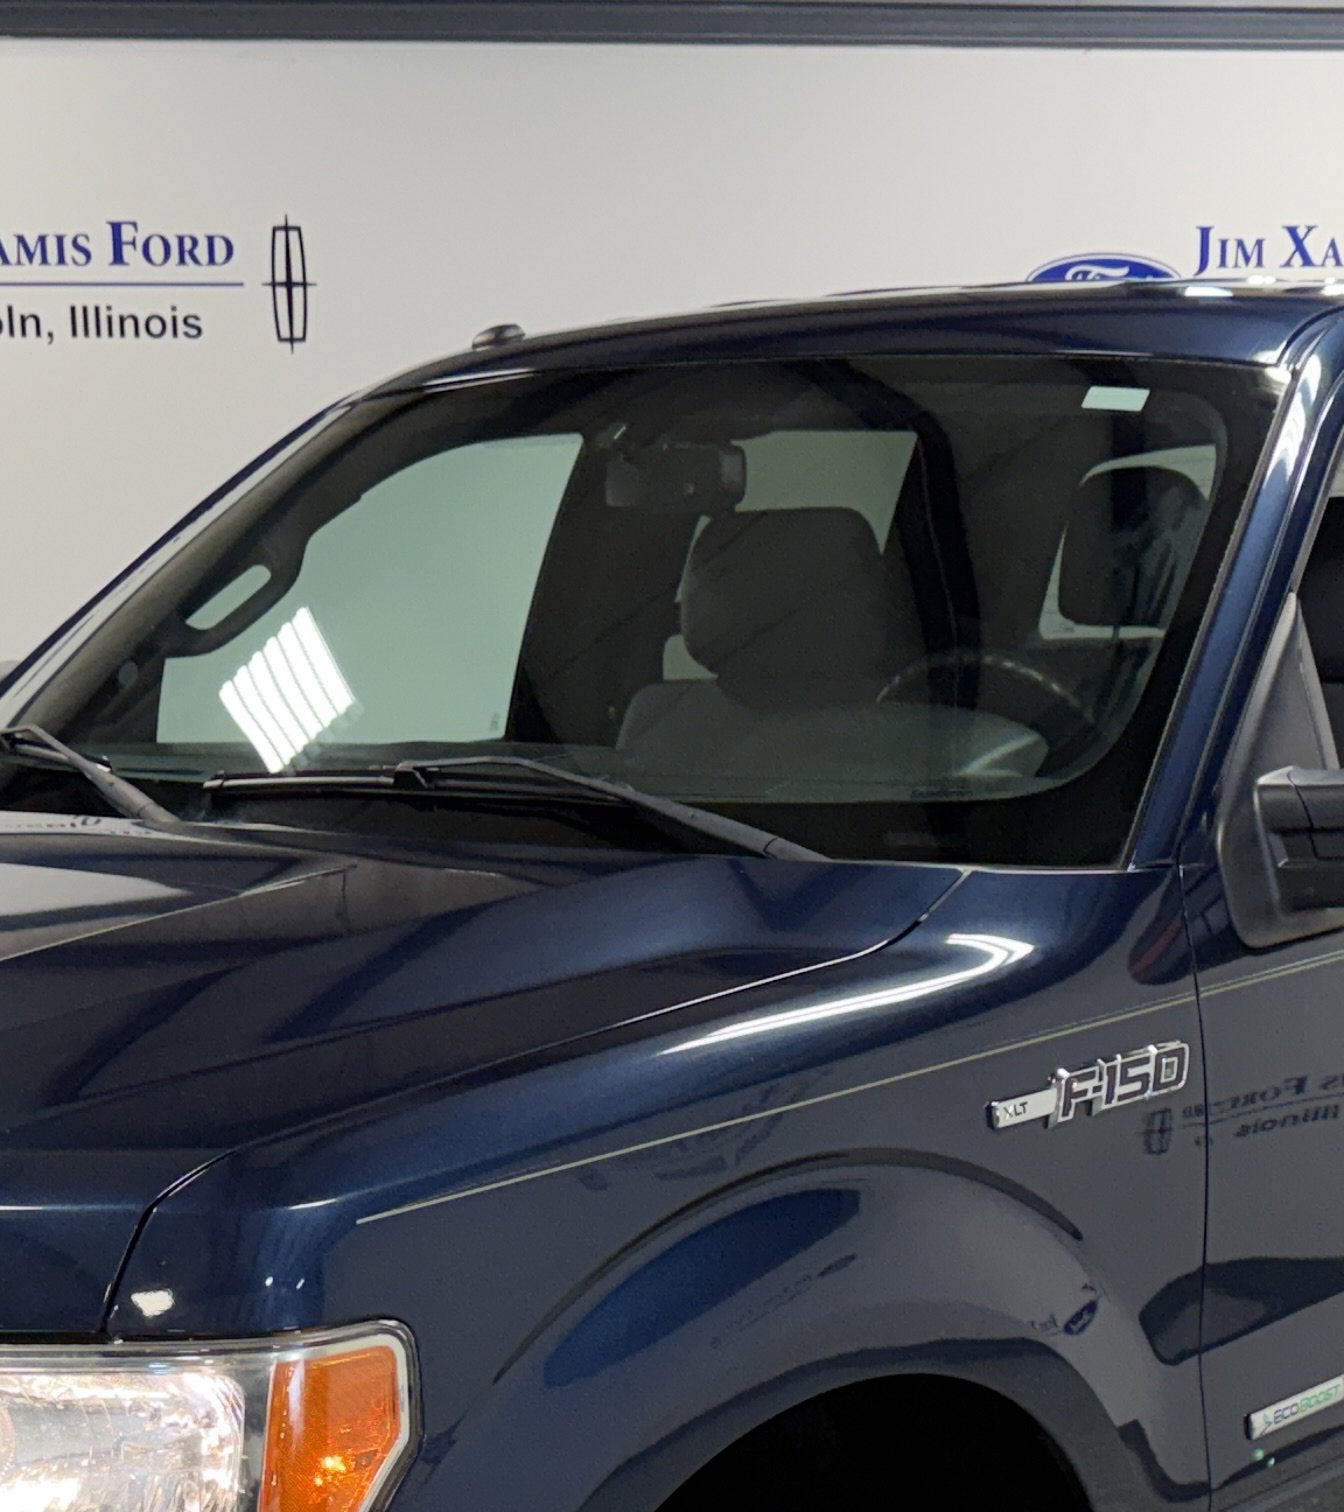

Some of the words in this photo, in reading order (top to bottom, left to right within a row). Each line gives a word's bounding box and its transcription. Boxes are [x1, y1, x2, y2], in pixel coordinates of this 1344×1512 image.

[106, 221, 235, 267] FORD
[1194, 225, 1265, 277] JIM
[71, 305, 204, 339] Illinois
[1057, 1040, 1190, 1123] F-150
[1003, 1102, 1028, 1118] XLT
